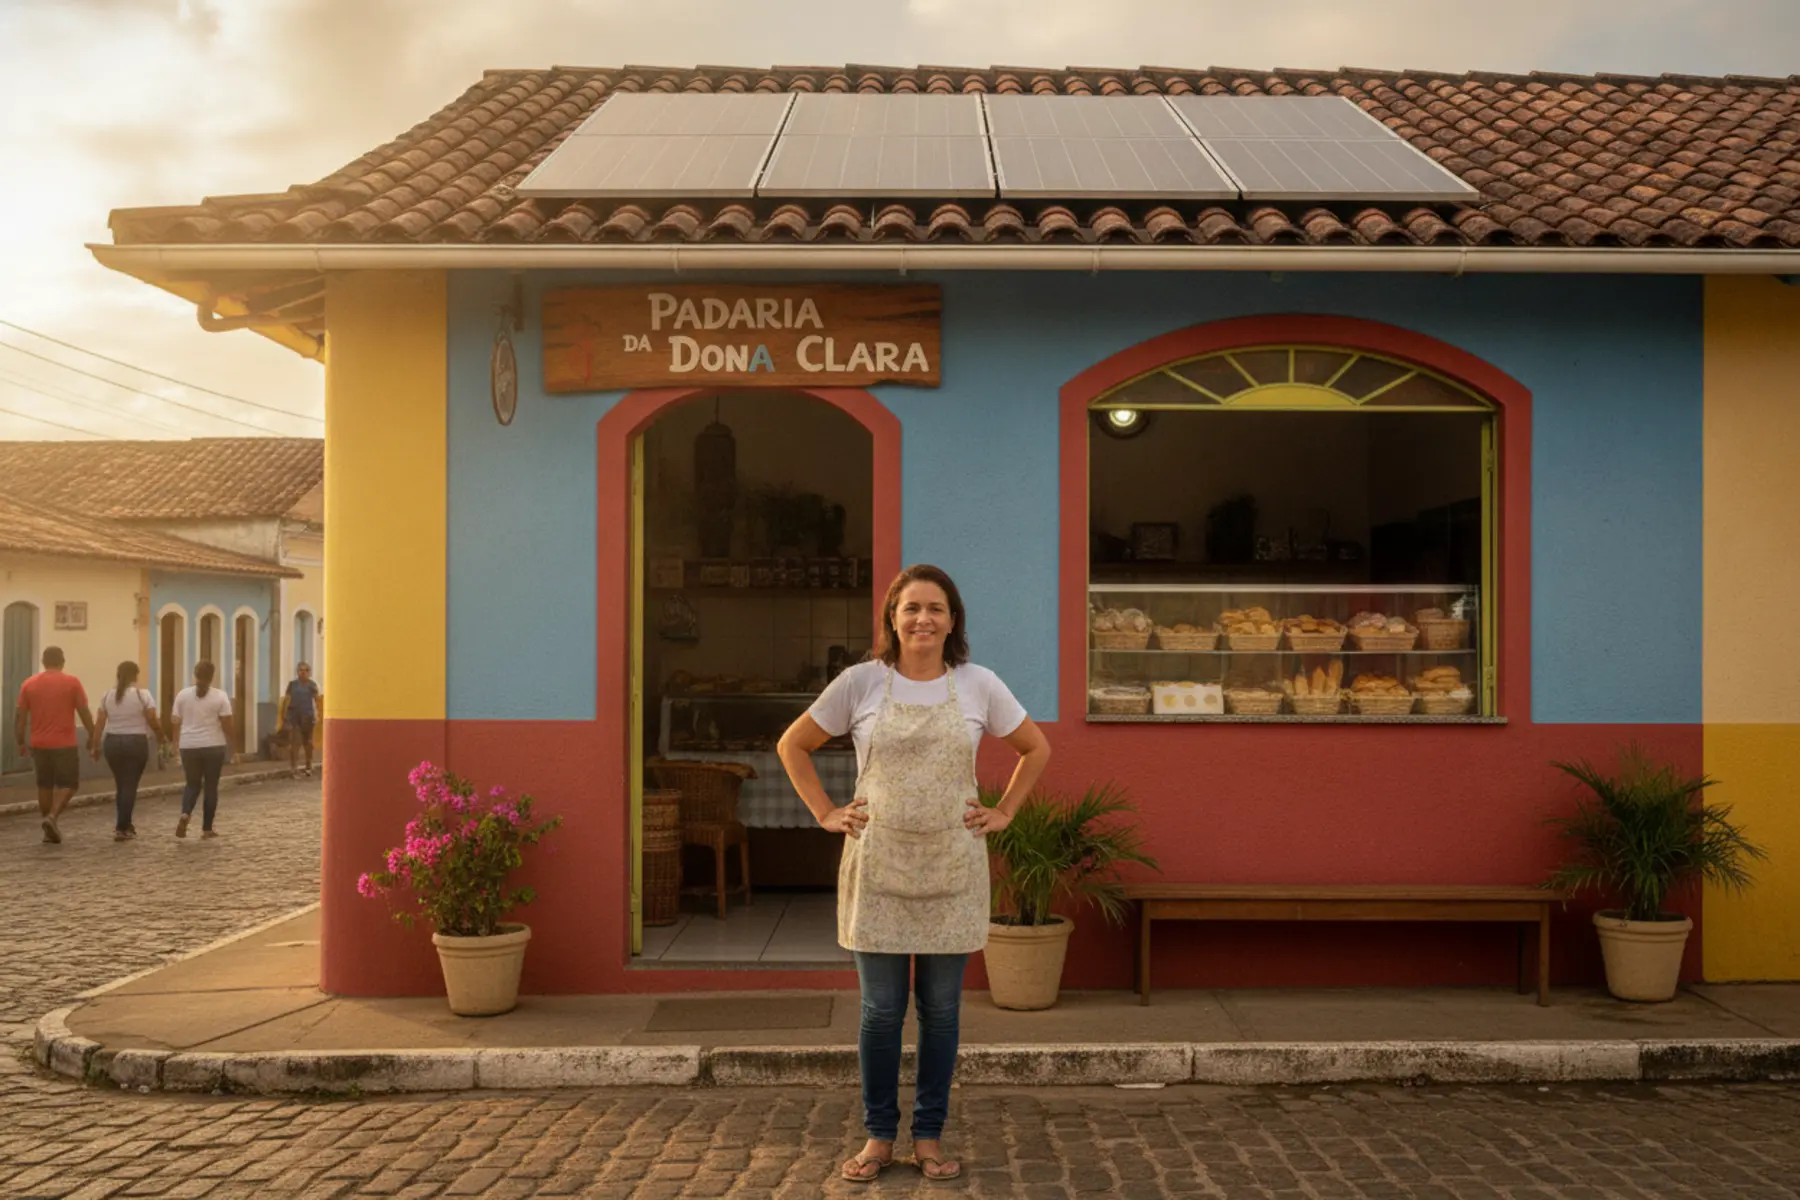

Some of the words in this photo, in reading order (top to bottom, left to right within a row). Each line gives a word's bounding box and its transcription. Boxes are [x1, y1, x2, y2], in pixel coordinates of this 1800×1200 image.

[648, 292, 824, 331] PADARIA
[623, 334, 652, 352] DA
[668, 335, 775, 373] DONA
[796, 335, 929, 373] CLARA
